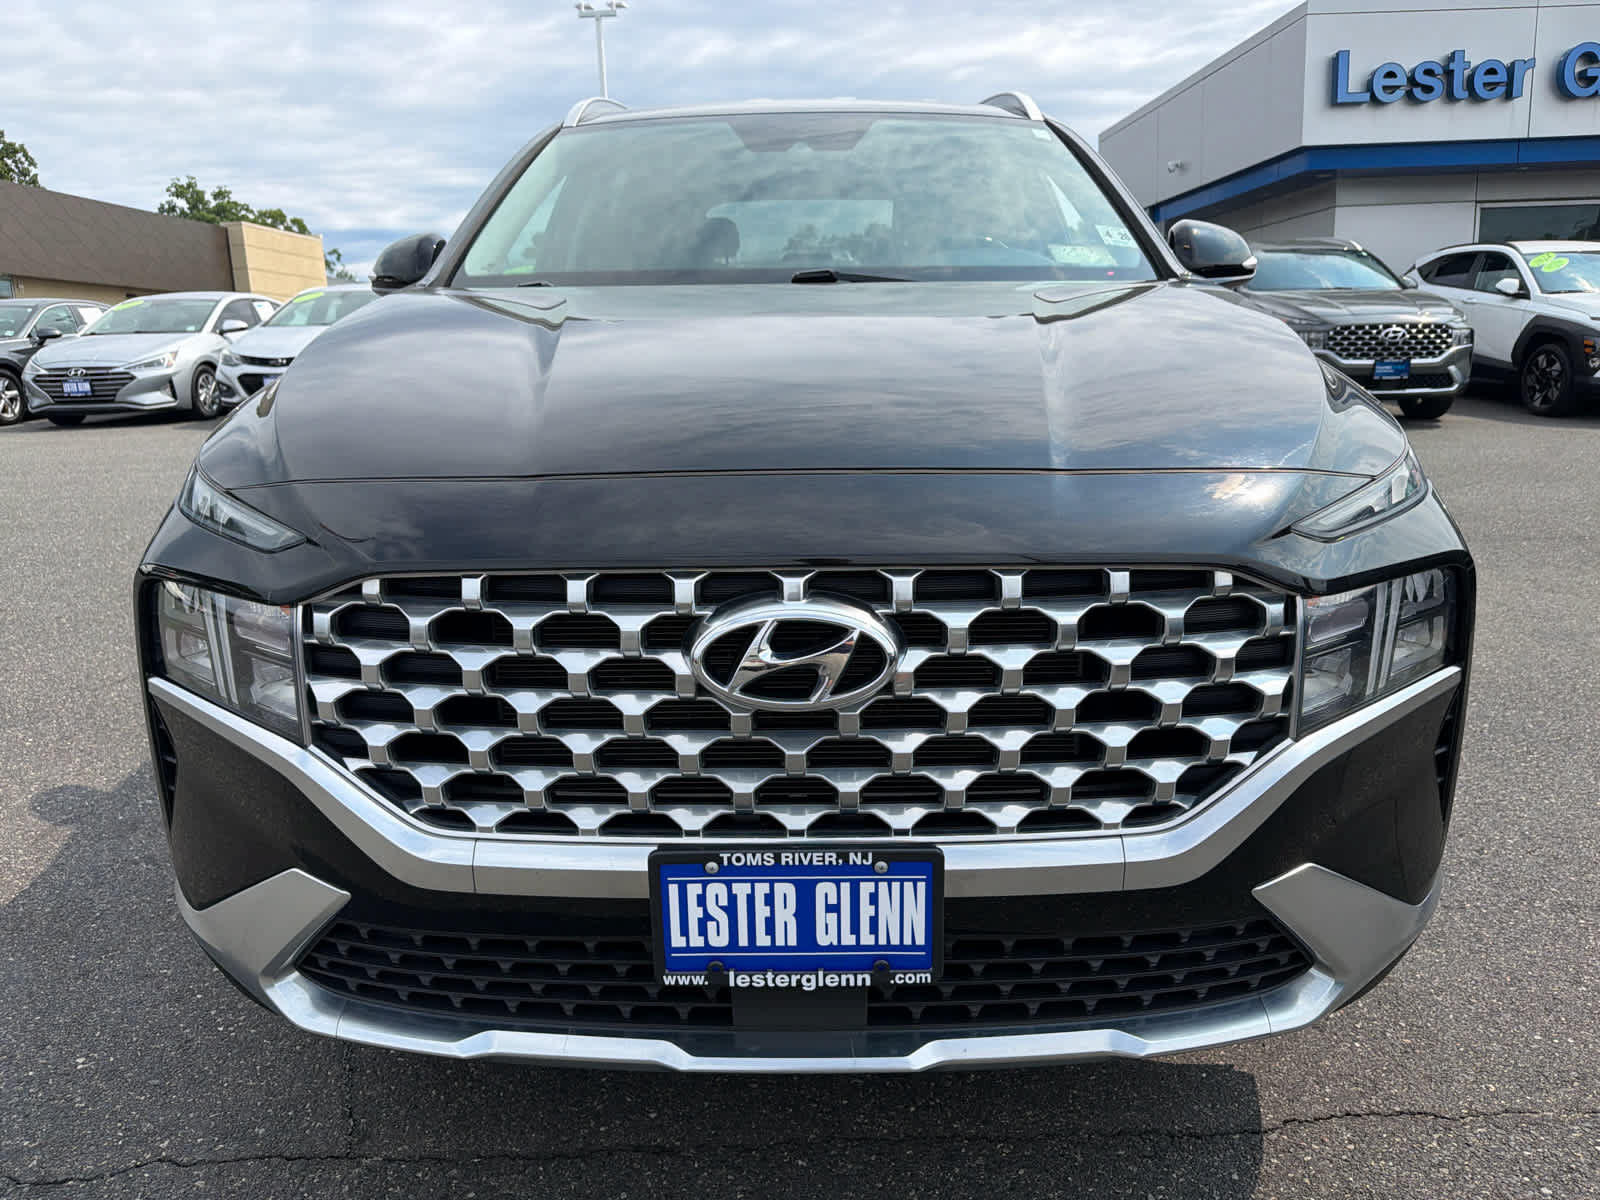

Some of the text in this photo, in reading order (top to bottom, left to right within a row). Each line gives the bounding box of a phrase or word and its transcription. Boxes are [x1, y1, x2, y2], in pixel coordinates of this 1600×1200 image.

[1332, 49, 1536, 104] Lester
[719, 852, 873, 866] TOMS RIVER, NJ
[668, 881, 926, 948] LESTER GLENN
[663, 971, 932, 991] www. lesterglenn .com
